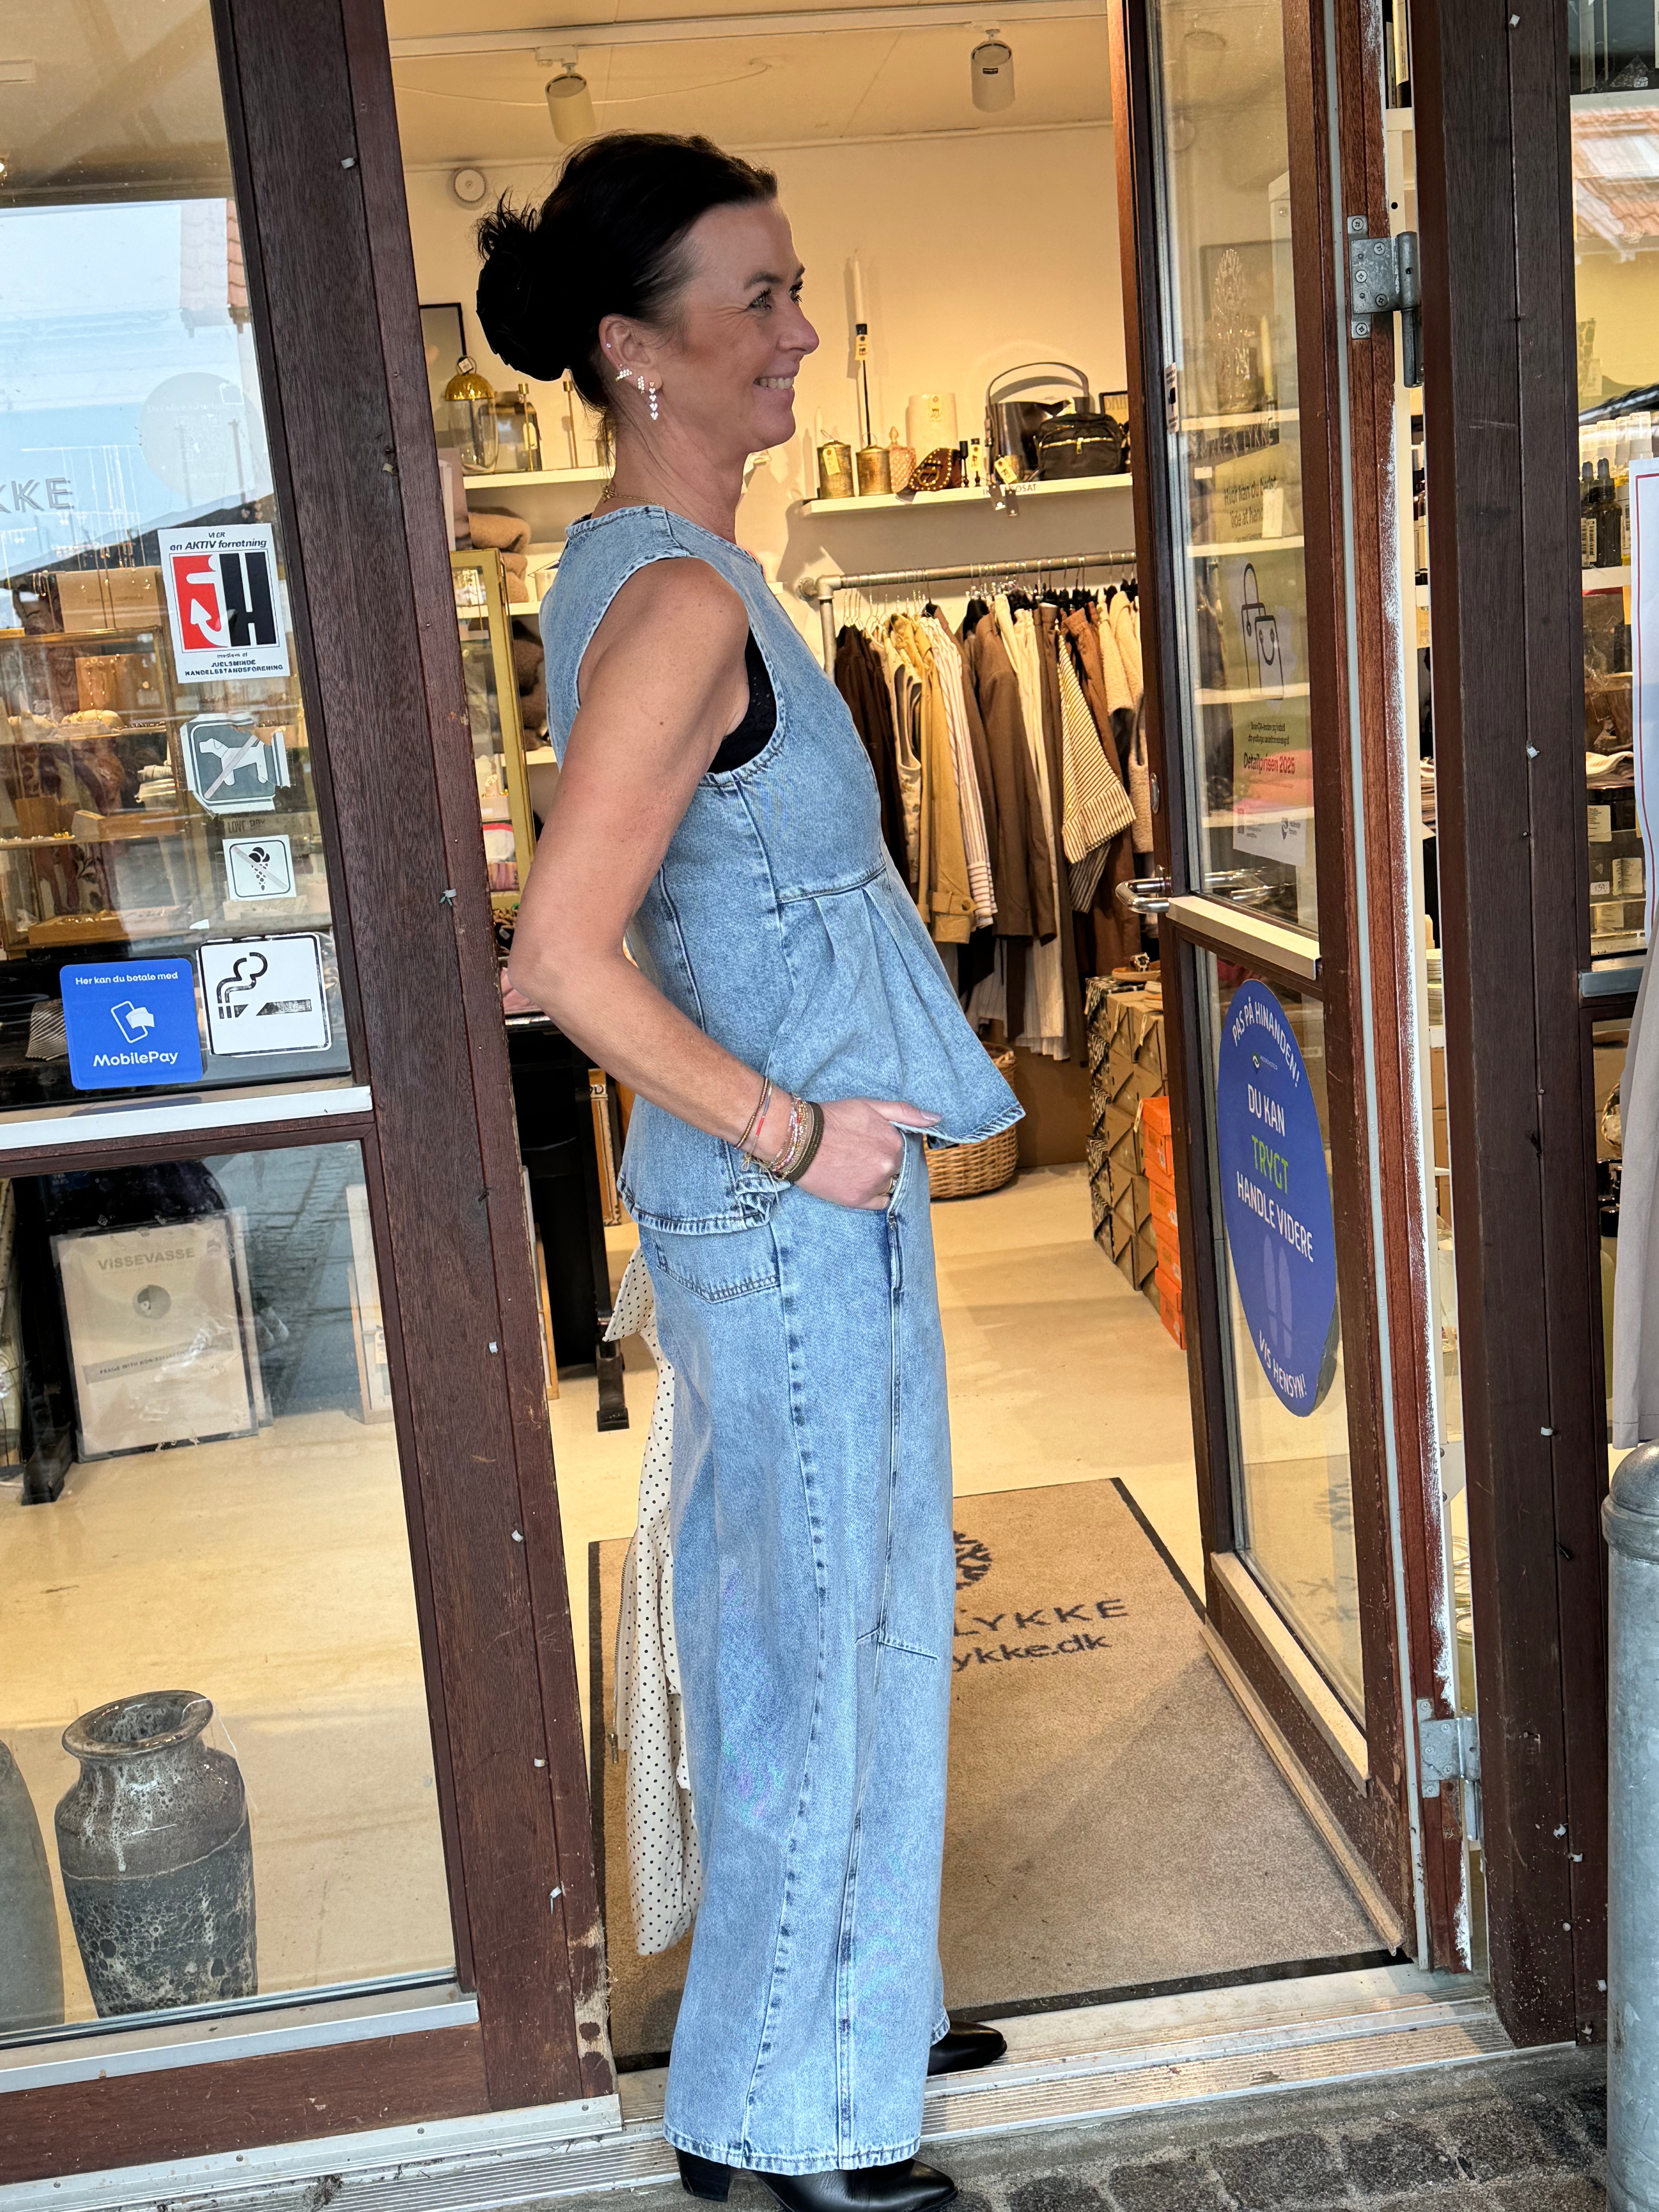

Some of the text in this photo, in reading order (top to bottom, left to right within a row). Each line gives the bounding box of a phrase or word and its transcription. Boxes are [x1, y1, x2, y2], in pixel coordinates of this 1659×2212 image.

[185, 541, 216, 550] AKTIV
[218, 538, 267, 548] forretning
[1243, 752, 1278, 774] Detailprisen
[127, 974, 156, 982] betale
[157, 971, 178, 979] med
[93, 1051, 179, 1068] MobilePay
[1232, 996, 1300, 1087] PAS PÅ HINANDEN!
[1247, 1083, 1285, 1137] DU KAN
[1251, 1135, 1288, 1194] TRYGT
[1237, 1171, 1314, 1263] HANDLE VIDERE
[1259, 1330, 1307, 1399] VIS HENSYN!
